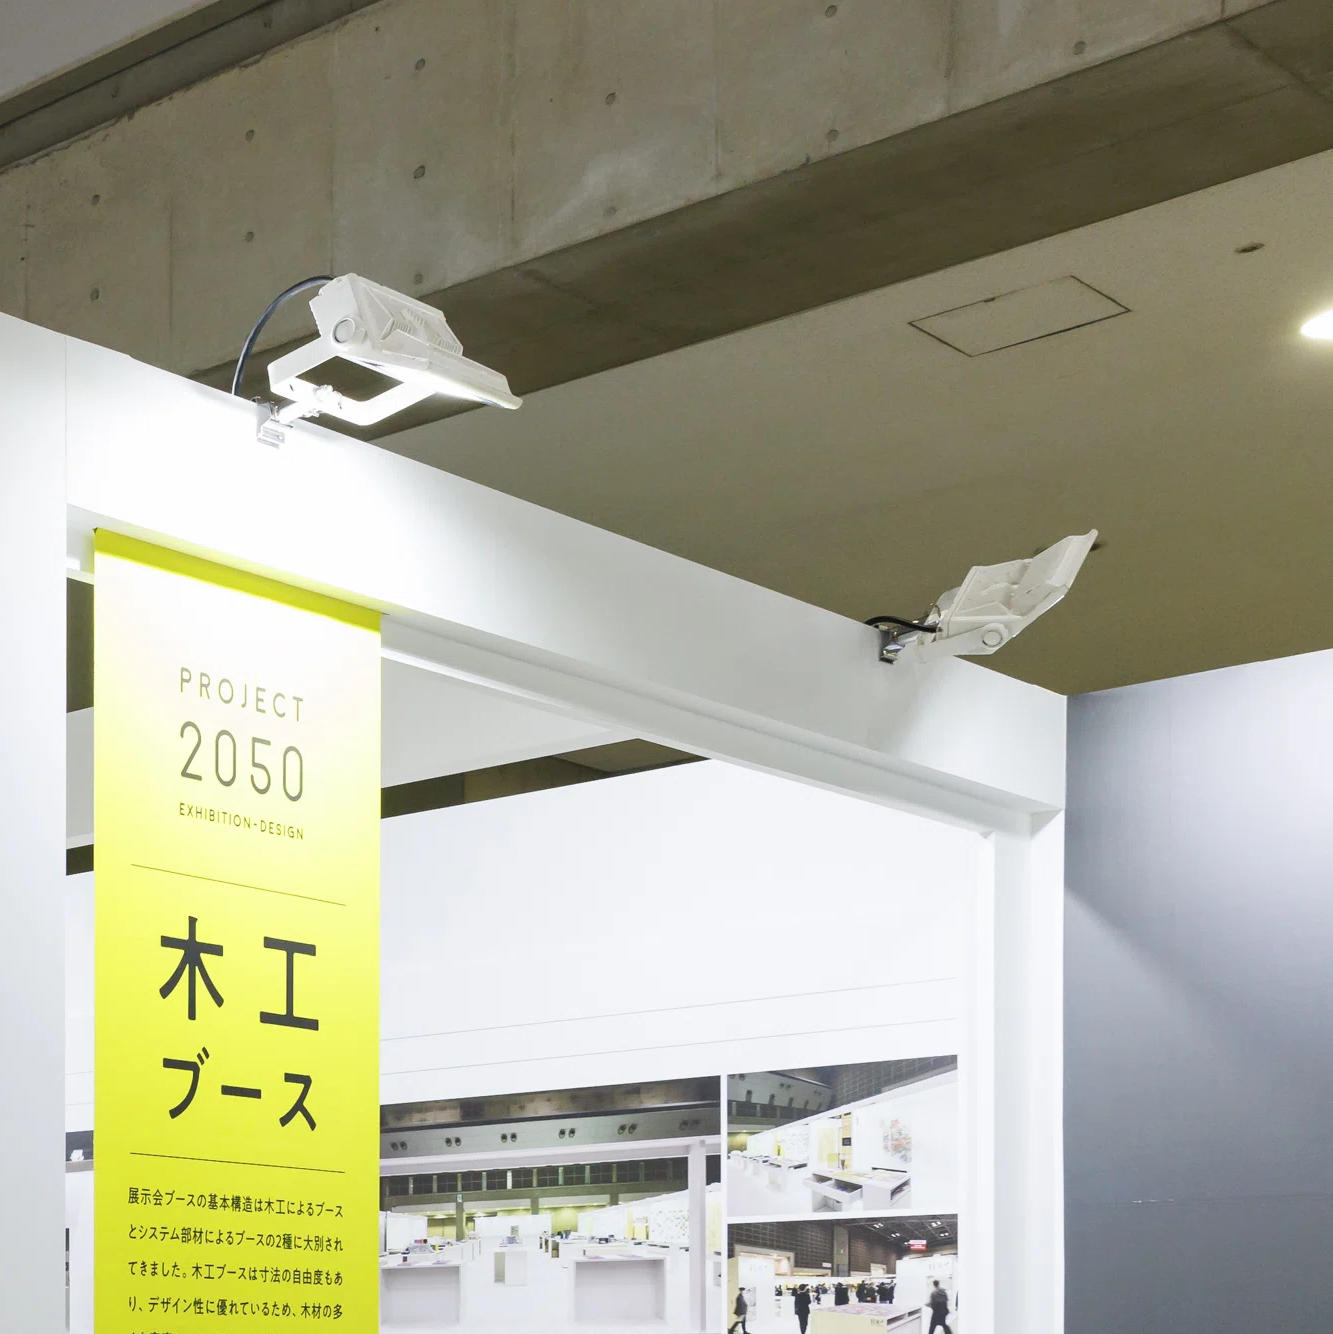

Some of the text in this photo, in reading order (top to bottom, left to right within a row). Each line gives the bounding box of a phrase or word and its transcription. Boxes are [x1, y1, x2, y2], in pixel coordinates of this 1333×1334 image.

[179, 666, 304, 722] PROJECT
[179, 720, 303, 802] 2050
[179, 802, 304, 841] EXHIBITION-DESIGN
[159, 915, 319, 1031] 木工
[162, 1046, 316, 1132] ブース
